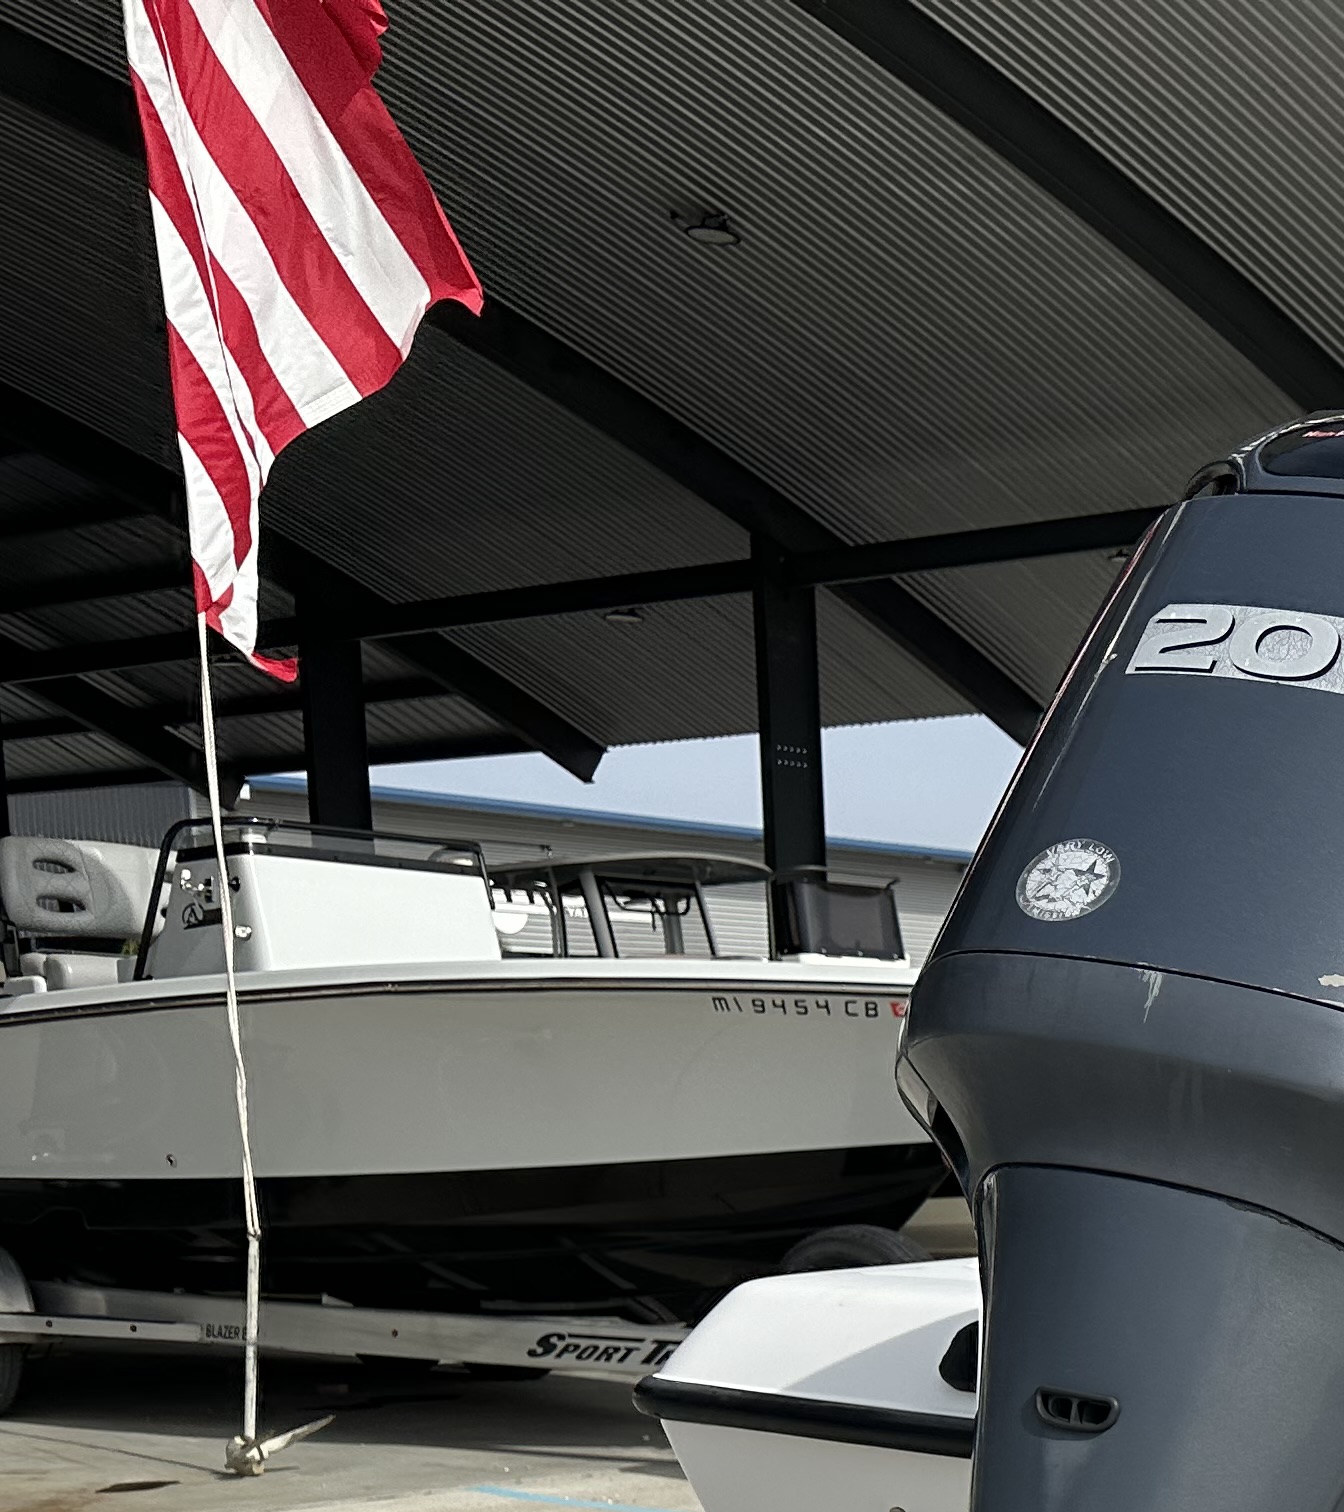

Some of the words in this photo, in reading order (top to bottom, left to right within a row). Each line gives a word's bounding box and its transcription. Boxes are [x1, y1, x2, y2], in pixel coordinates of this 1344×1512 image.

[1089, 842, 1116, 864] LOW
[712, 996, 743, 1012] MI
[752, 998, 831, 1016] 9454
[844, 1000, 879, 1018] CB
[206, 1323, 240, 1340] BLAZER
[527, 1332, 641, 1364] SPORT
